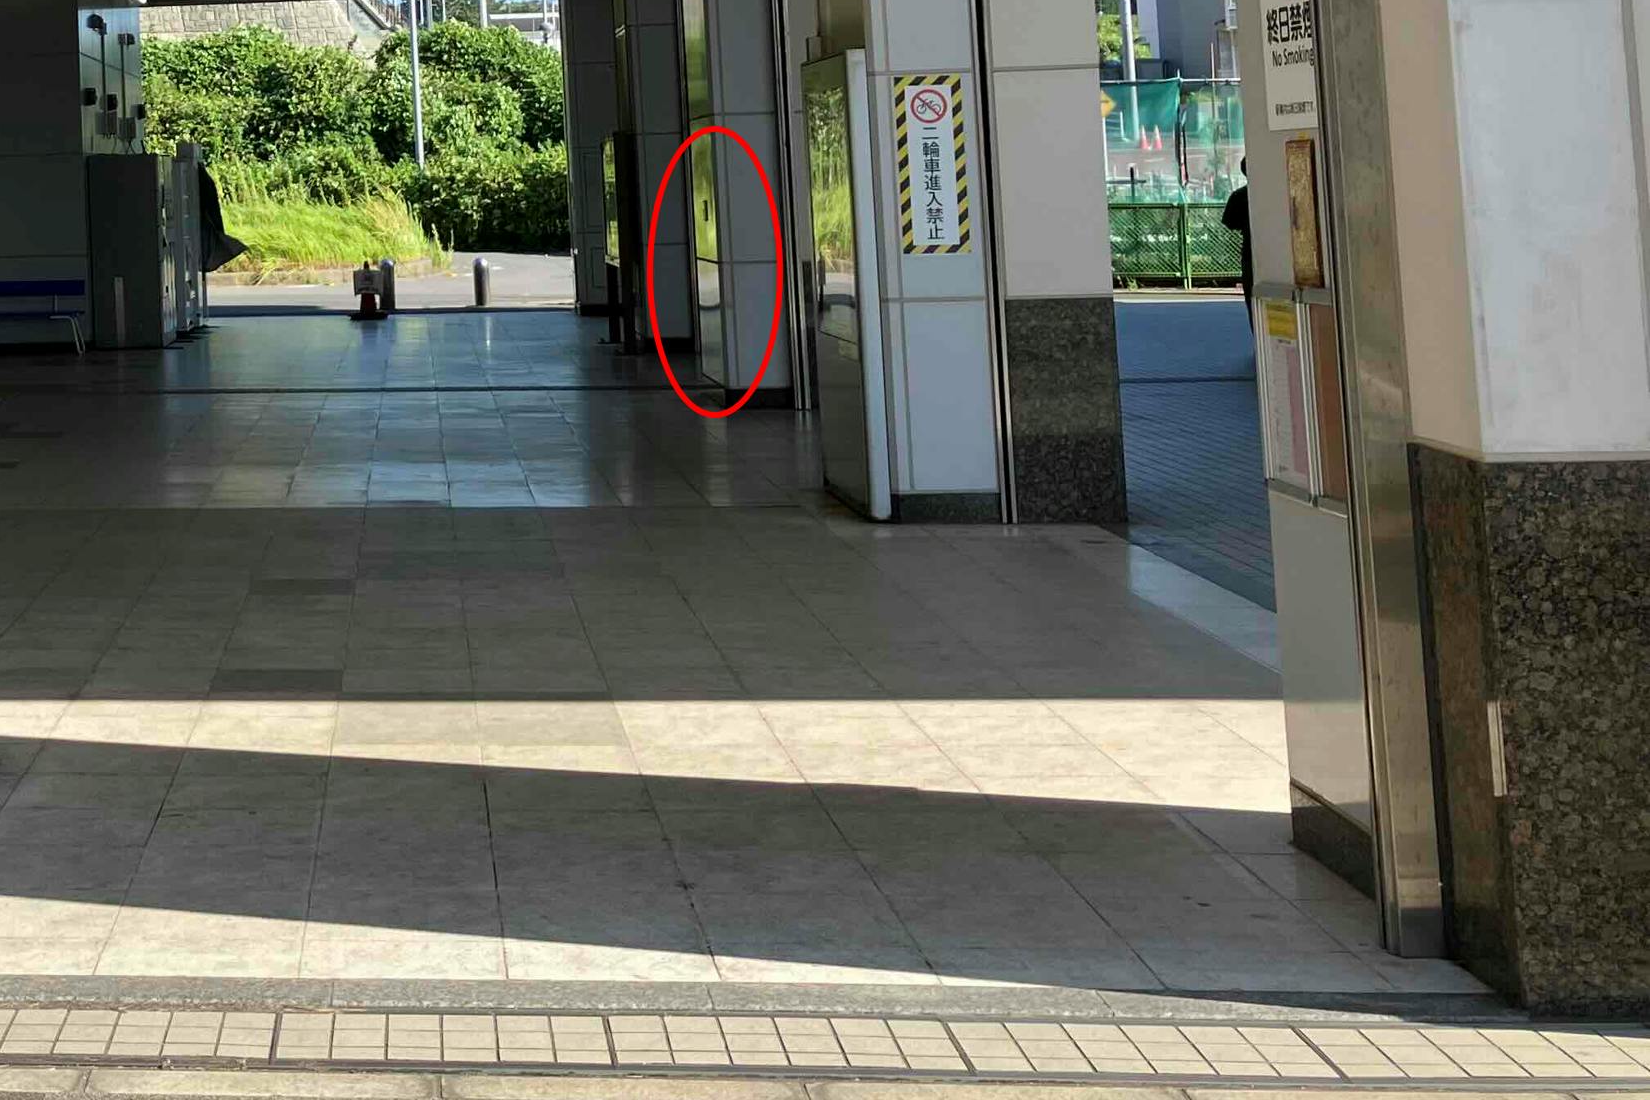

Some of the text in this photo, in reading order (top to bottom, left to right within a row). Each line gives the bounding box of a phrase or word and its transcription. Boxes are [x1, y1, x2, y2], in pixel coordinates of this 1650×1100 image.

[1271, 45, 1315, 68] No Smoking
[921, 126, 945, 241] 二輪車進入禁止
